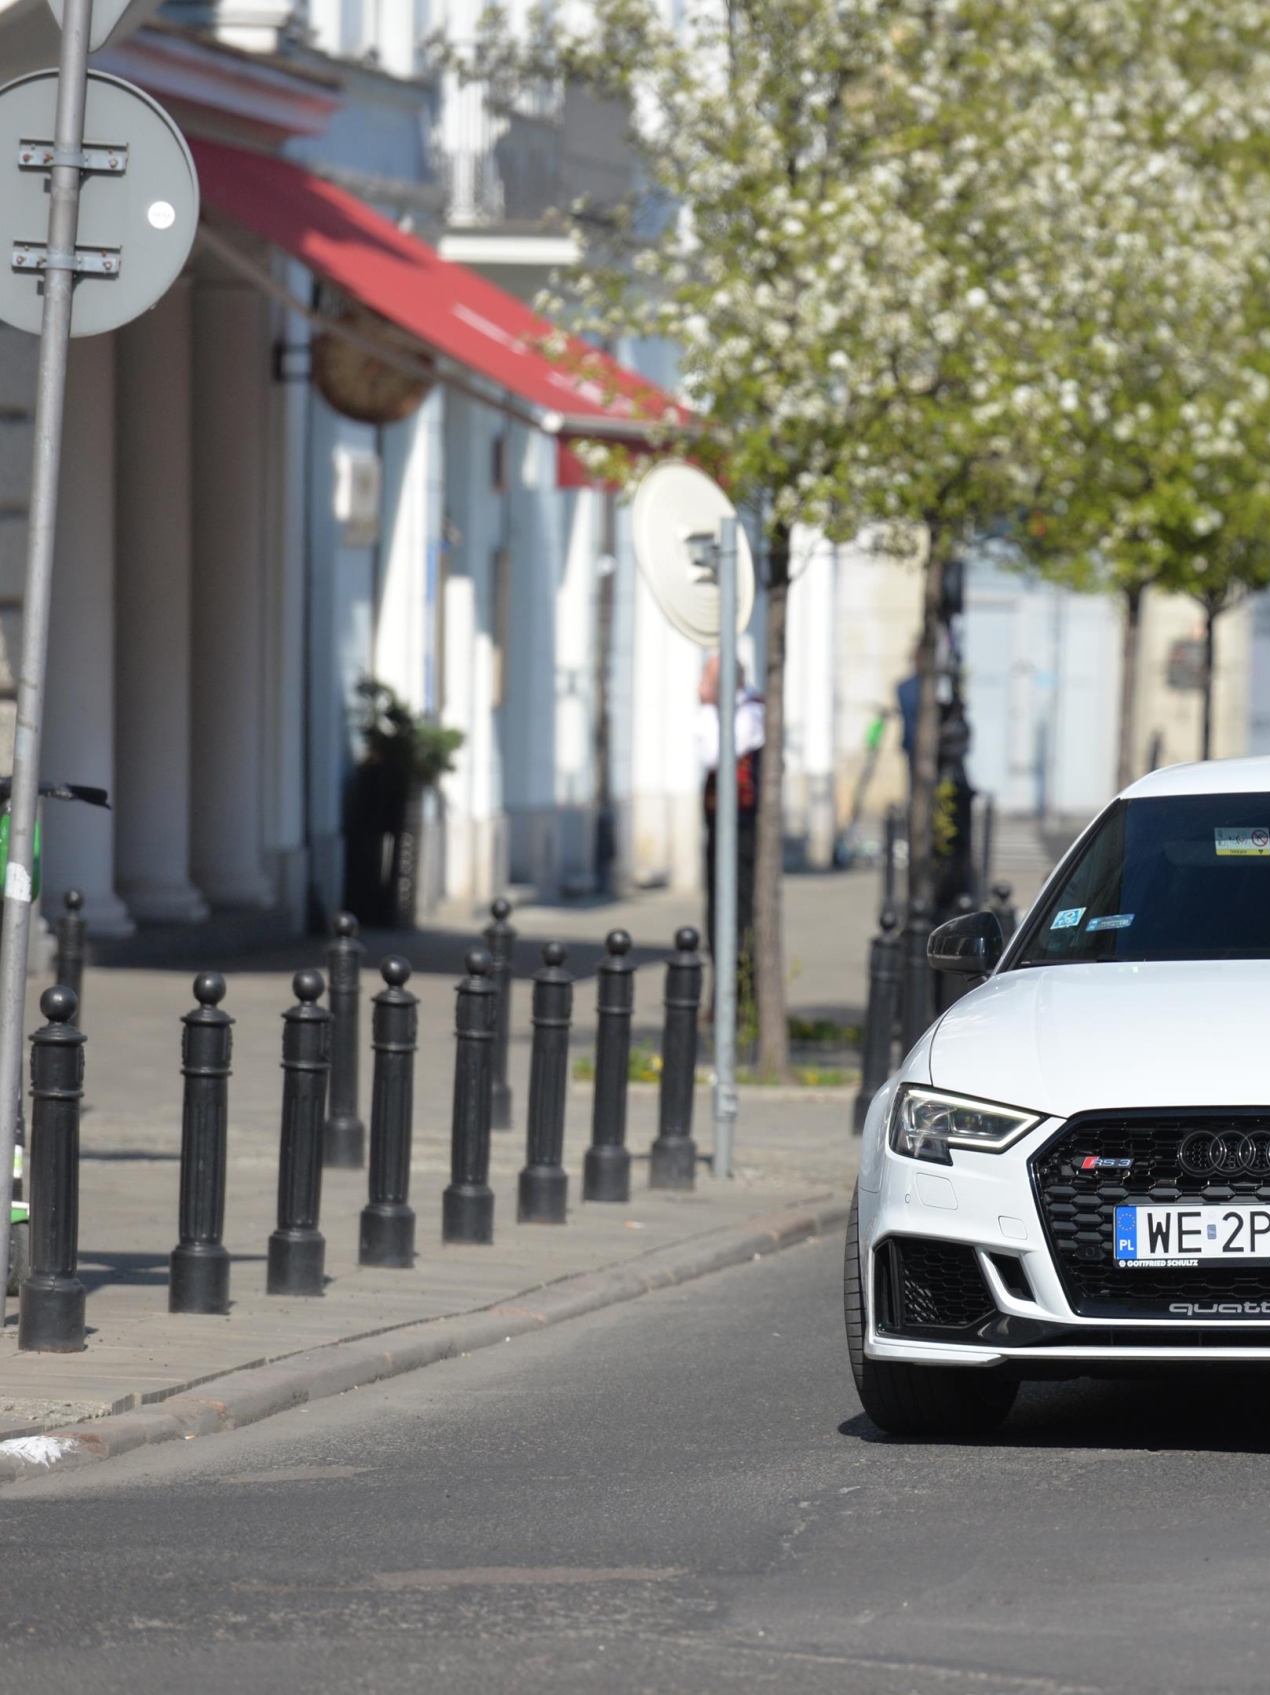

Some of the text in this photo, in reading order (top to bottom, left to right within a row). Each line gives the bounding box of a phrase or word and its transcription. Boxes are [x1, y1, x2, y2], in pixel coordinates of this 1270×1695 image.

[1092, 1158, 1131, 1167] RS 3
[1147, 1212, 1202, 1254] WE
[1119, 1239, 1135, 1251] PL
[1166, 1259, 1198, 1267] SCHULTZ
